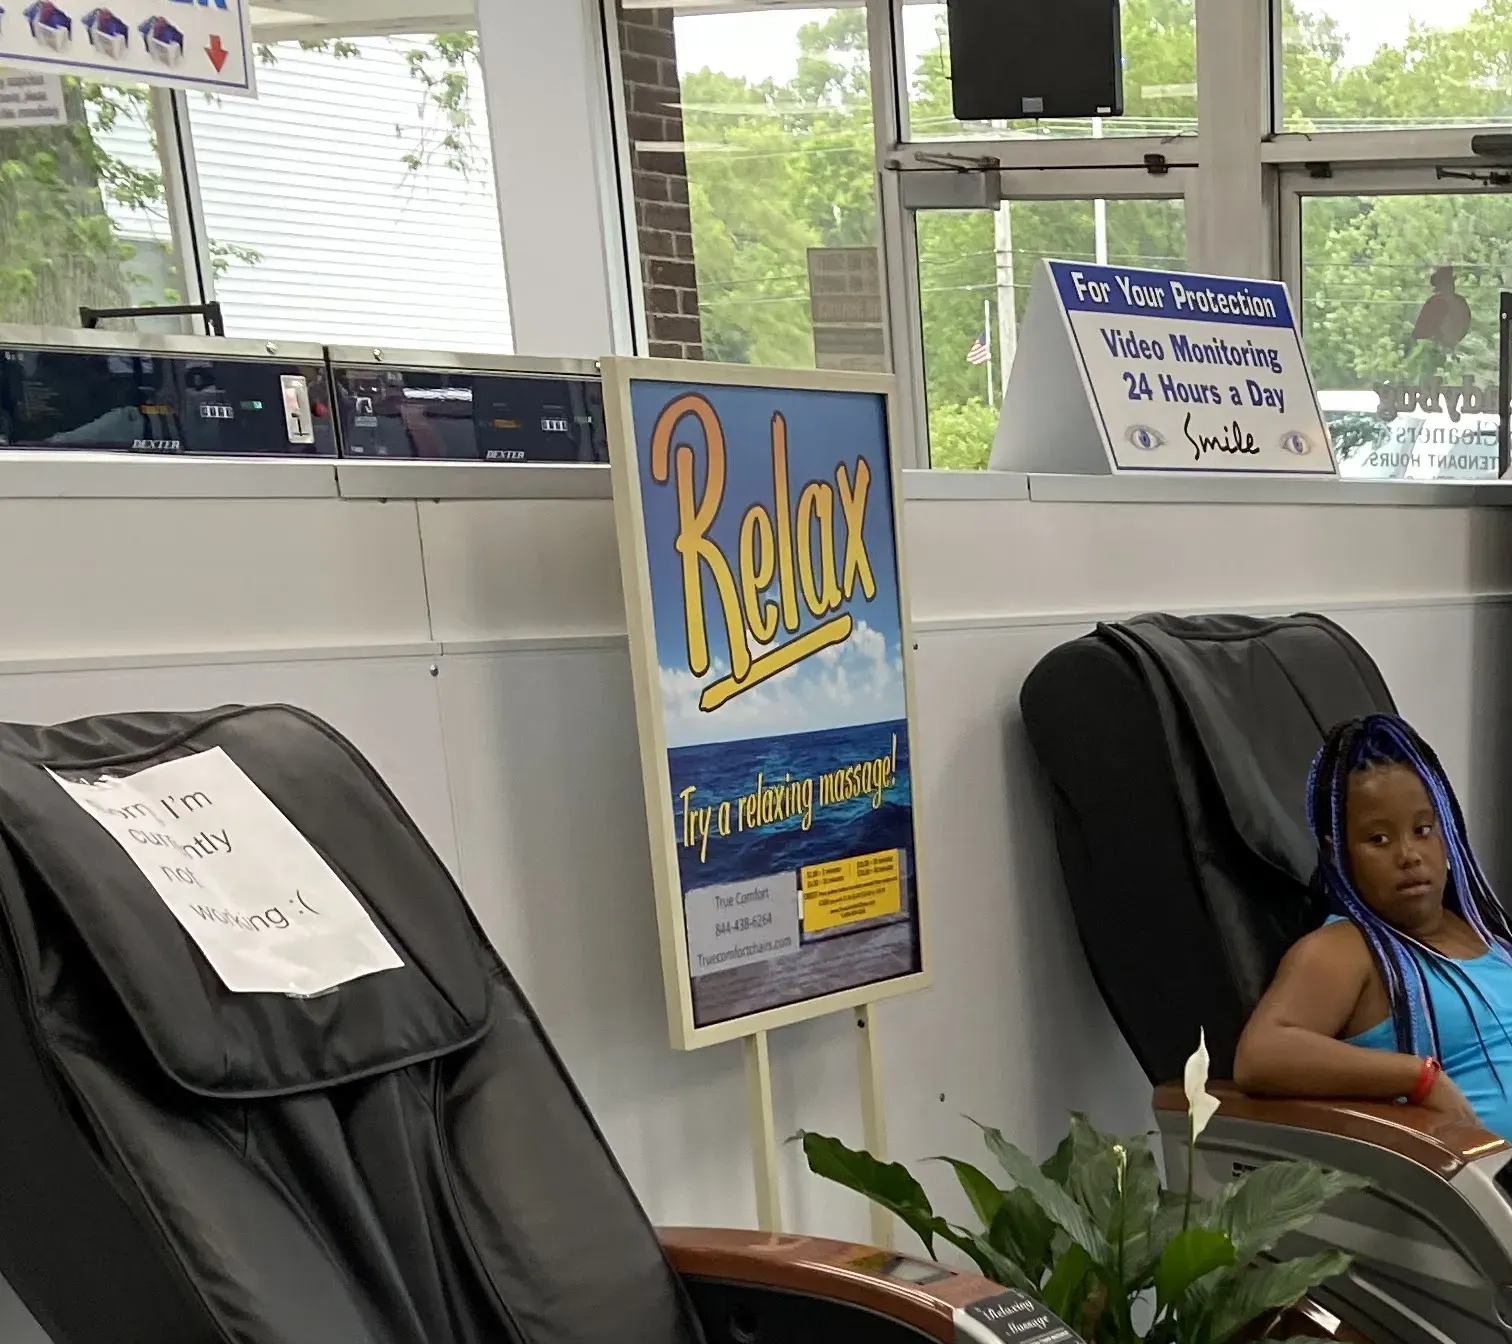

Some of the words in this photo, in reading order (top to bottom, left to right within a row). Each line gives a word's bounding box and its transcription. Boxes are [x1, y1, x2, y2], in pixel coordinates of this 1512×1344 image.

[1070, 271, 1111, 303] For
[1115, 275, 1165, 308] Your
[1169, 280, 1277, 318] Protection
[1100, 328, 1165, 360] Video
[1169, 333, 1283, 374] Monitoring
[1122, 371, 1154, 401] 24
[1158, 373, 1222, 406] Hours
[1228, 390, 1243, 406] a
[1246, 379, 1285, 414] Day
[131, 439, 181, 450] DEXTER
[486, 449, 525, 460] DEXTER
[1184, 412, 1260, 461] Smile
[651, 392, 876, 683] Relax
[160, 791, 213, 819] I'm
[679, 785, 711, 863] Try
[718, 801, 731, 836] a
[737, 772, 813, 832] relaxing
[819, 733, 897, 809] massage!
[160, 865, 204, 888] not
[714, 894, 734, 910] True
[735, 886, 769, 905] Comfort
